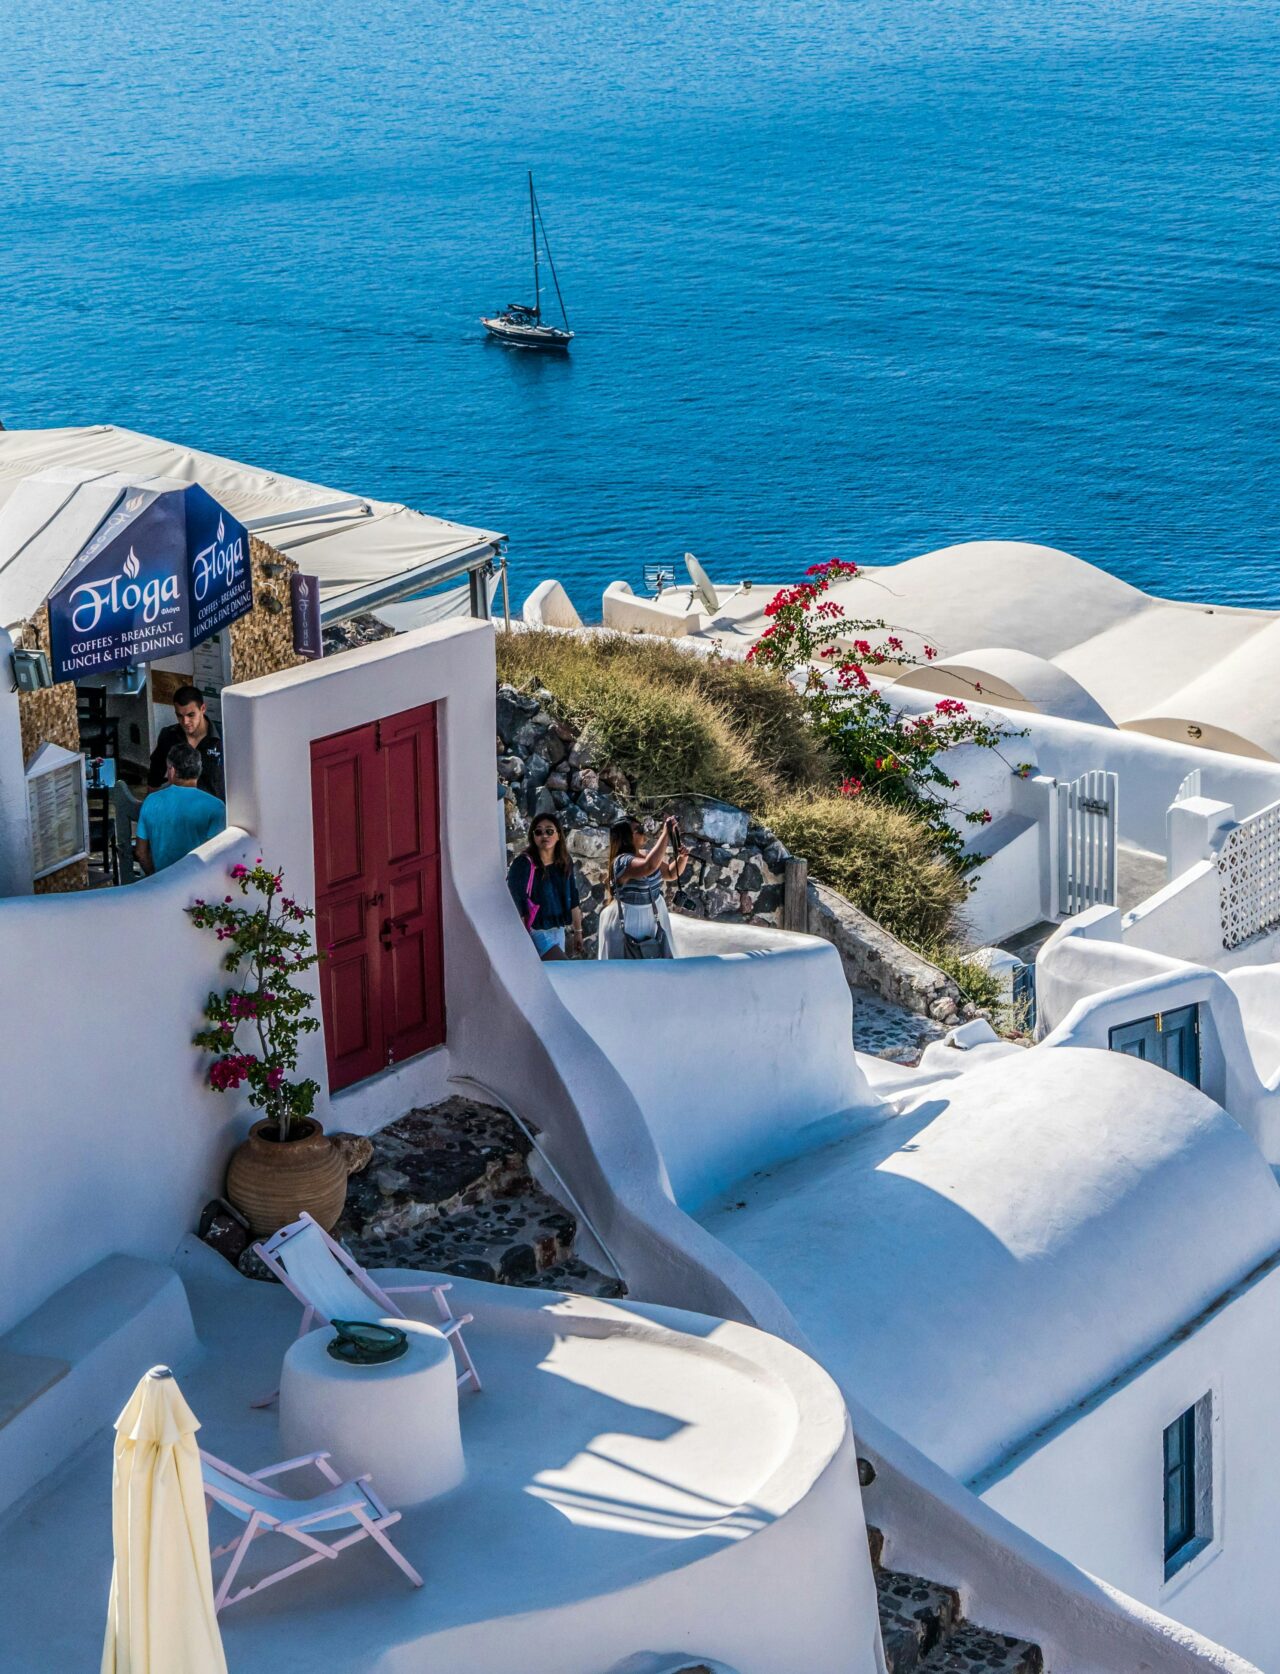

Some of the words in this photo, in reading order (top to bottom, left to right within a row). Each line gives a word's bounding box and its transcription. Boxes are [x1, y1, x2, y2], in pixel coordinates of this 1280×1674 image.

[192, 537, 243, 601] Floga
[69, 574, 181, 632] Floga
[194, 616, 213, 638] LUNCH
[218, 604, 230, 621] FINE
[230, 590, 251, 613] DINING
[198, 599, 218, 620] COFFEES
[221, 580, 246, 604] BREAKFAST
[62, 653, 101, 672] LUNCH
[103, 650, 113, 662] &
[114, 643, 139, 660] FINE
[141, 632, 184, 653] DINING
[71, 636, 113, 655] COFFEES
[121, 621, 174, 643] BREAKFAST
